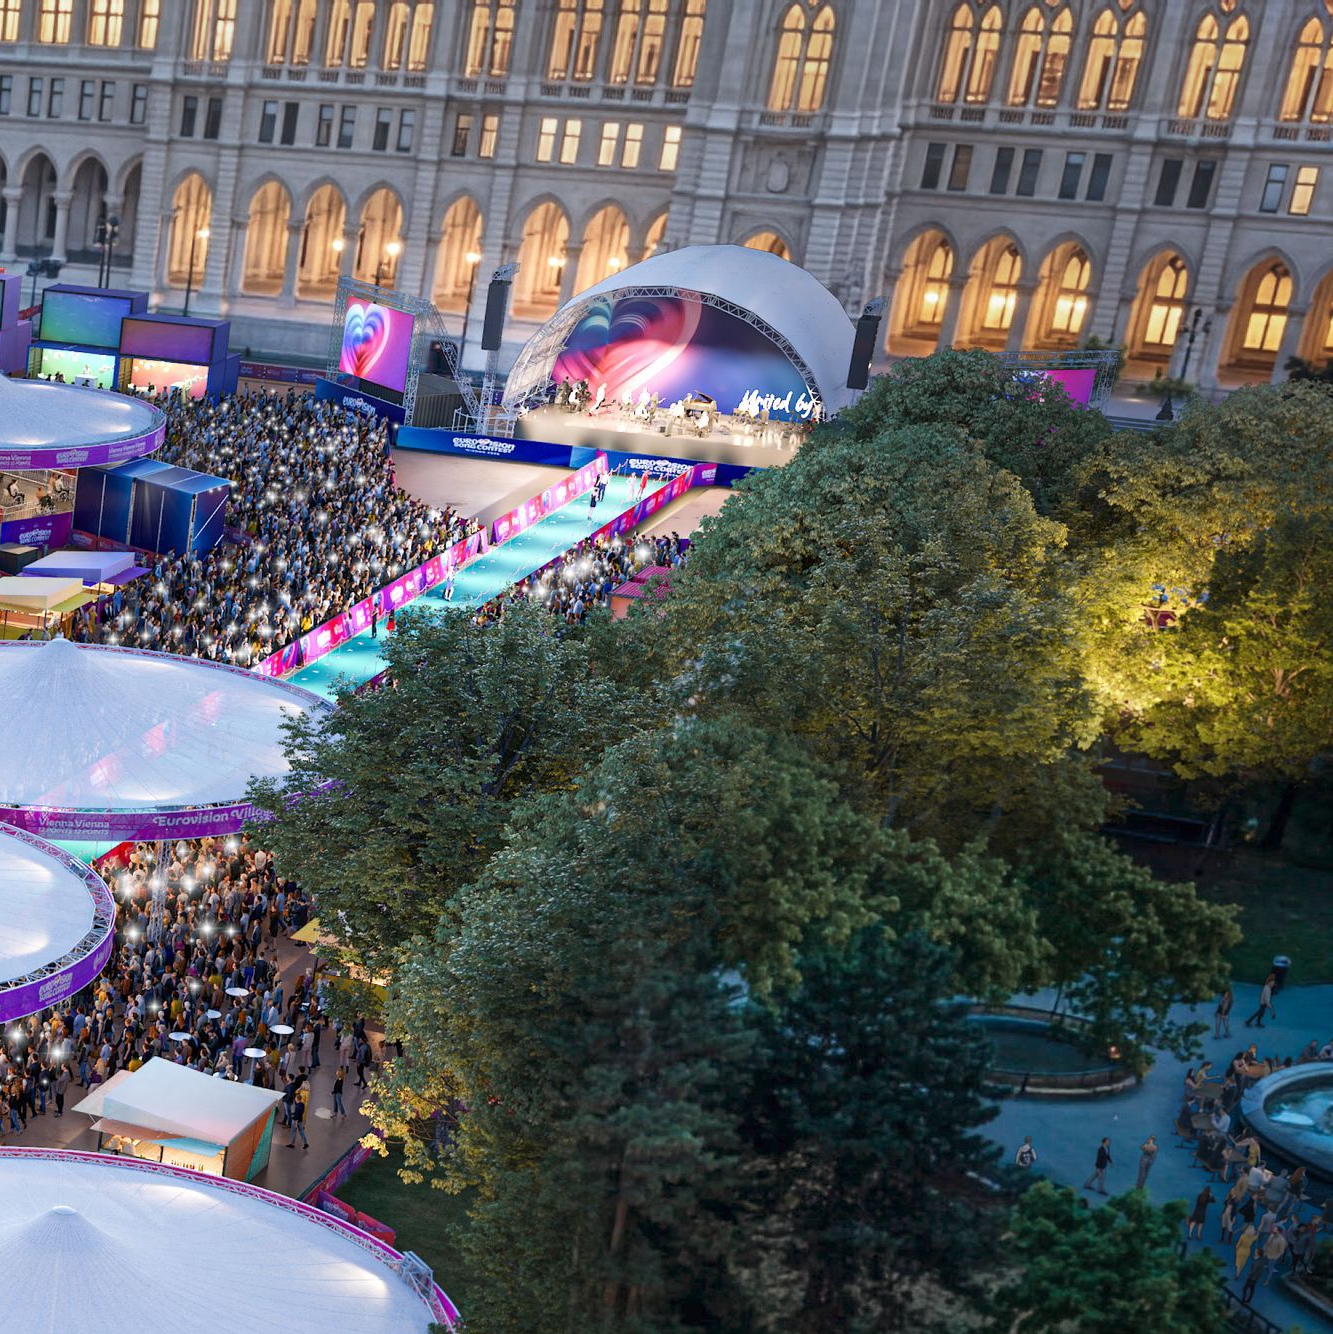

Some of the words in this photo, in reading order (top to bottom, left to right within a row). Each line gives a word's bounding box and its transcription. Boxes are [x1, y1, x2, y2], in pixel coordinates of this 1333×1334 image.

[738, 389, 793, 417] United
[39, 816, 73, 828] Vienna
[75, 819, 109, 828] Vienna
[153, 811, 229, 827] Eurovision
